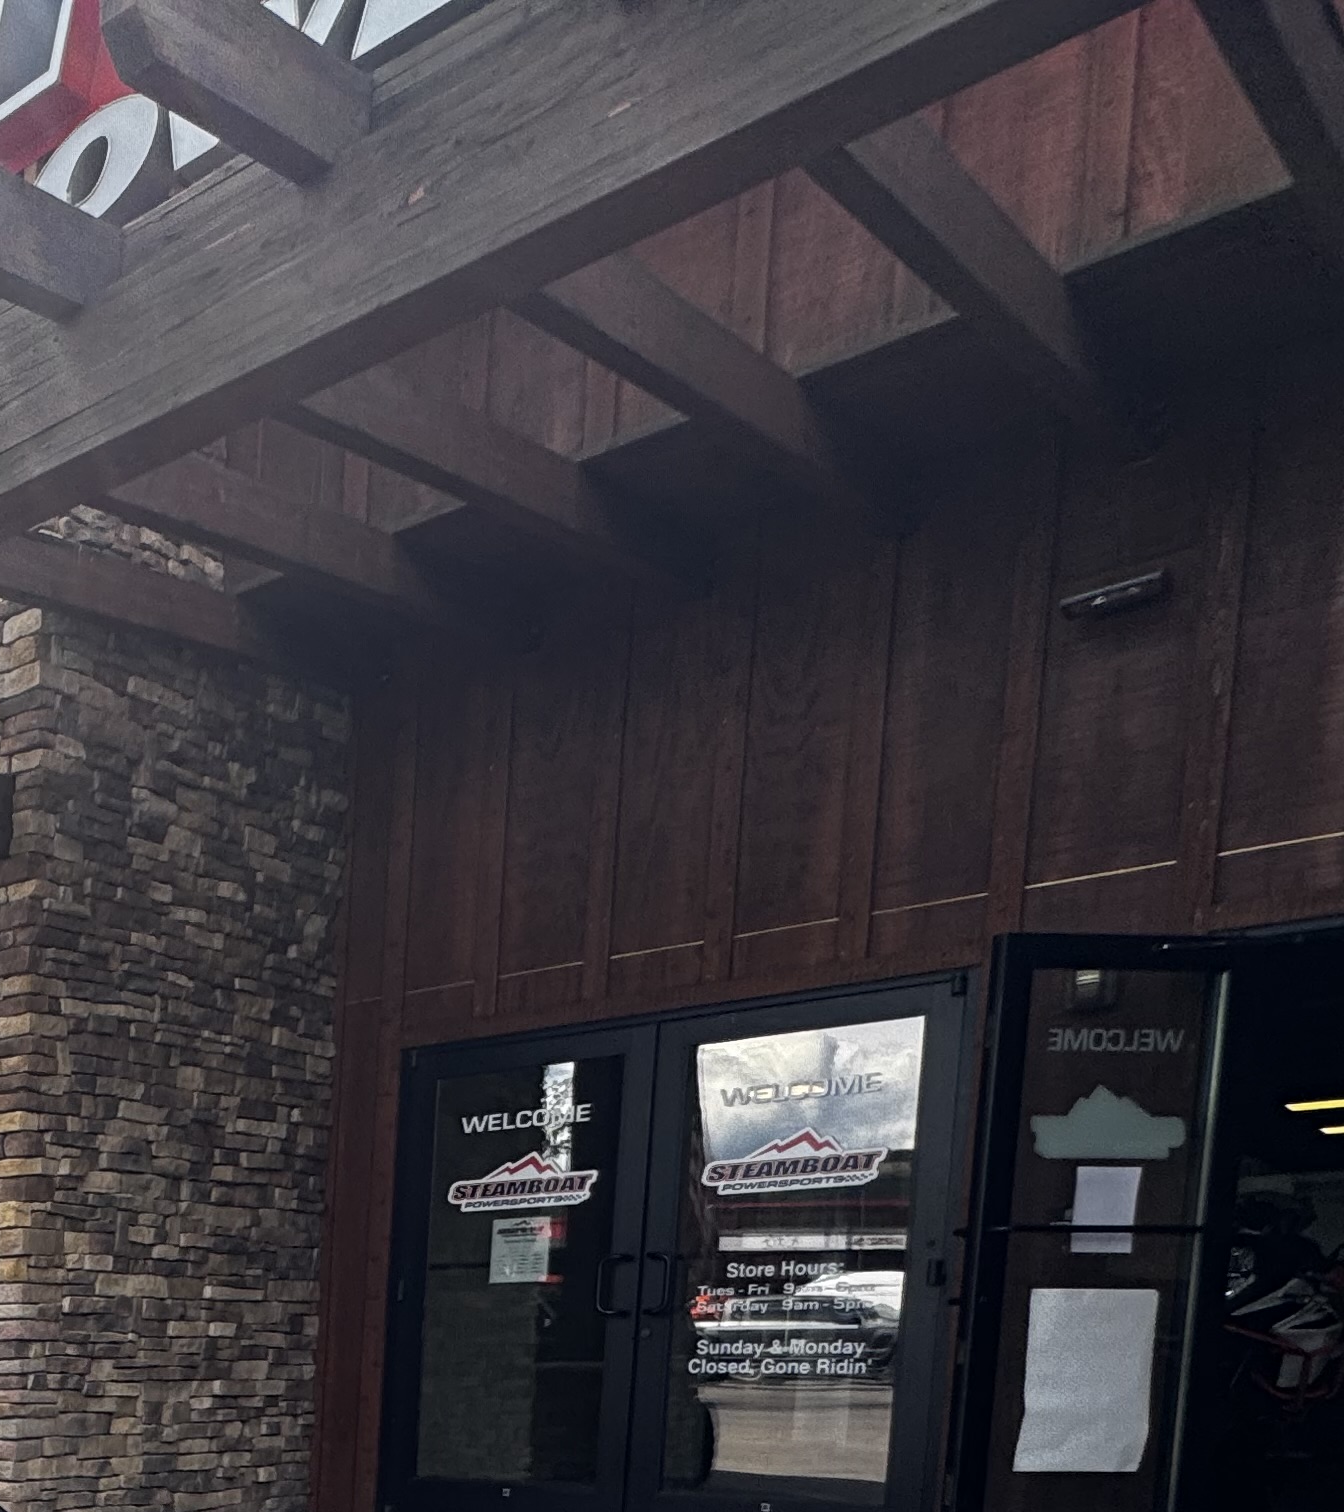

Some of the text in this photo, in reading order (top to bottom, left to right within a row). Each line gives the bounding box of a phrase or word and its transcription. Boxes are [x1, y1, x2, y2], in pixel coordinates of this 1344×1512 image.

[719, 1072, 883, 1107] WELCOME
[462, 1103, 592, 1134] WELCOME
[706, 1152, 882, 1183] STEAMBOAT
[453, 1172, 594, 1200] STEAMBOAT
[721, 1174, 844, 1192] POWERSPORTS
[464, 1193, 563, 1209] POWERSPORTS
[726, 1260, 844, 1278] Store Hours:
[697, 1285, 735, 1296] Tues
[747, 1283, 770, 1295] Fri
[781, 1299, 819, 1311] 9am
[696, 1339, 866, 1357] Sunday & Monday
[688, 1358, 873, 1376] Closed, Gone Ridin'
